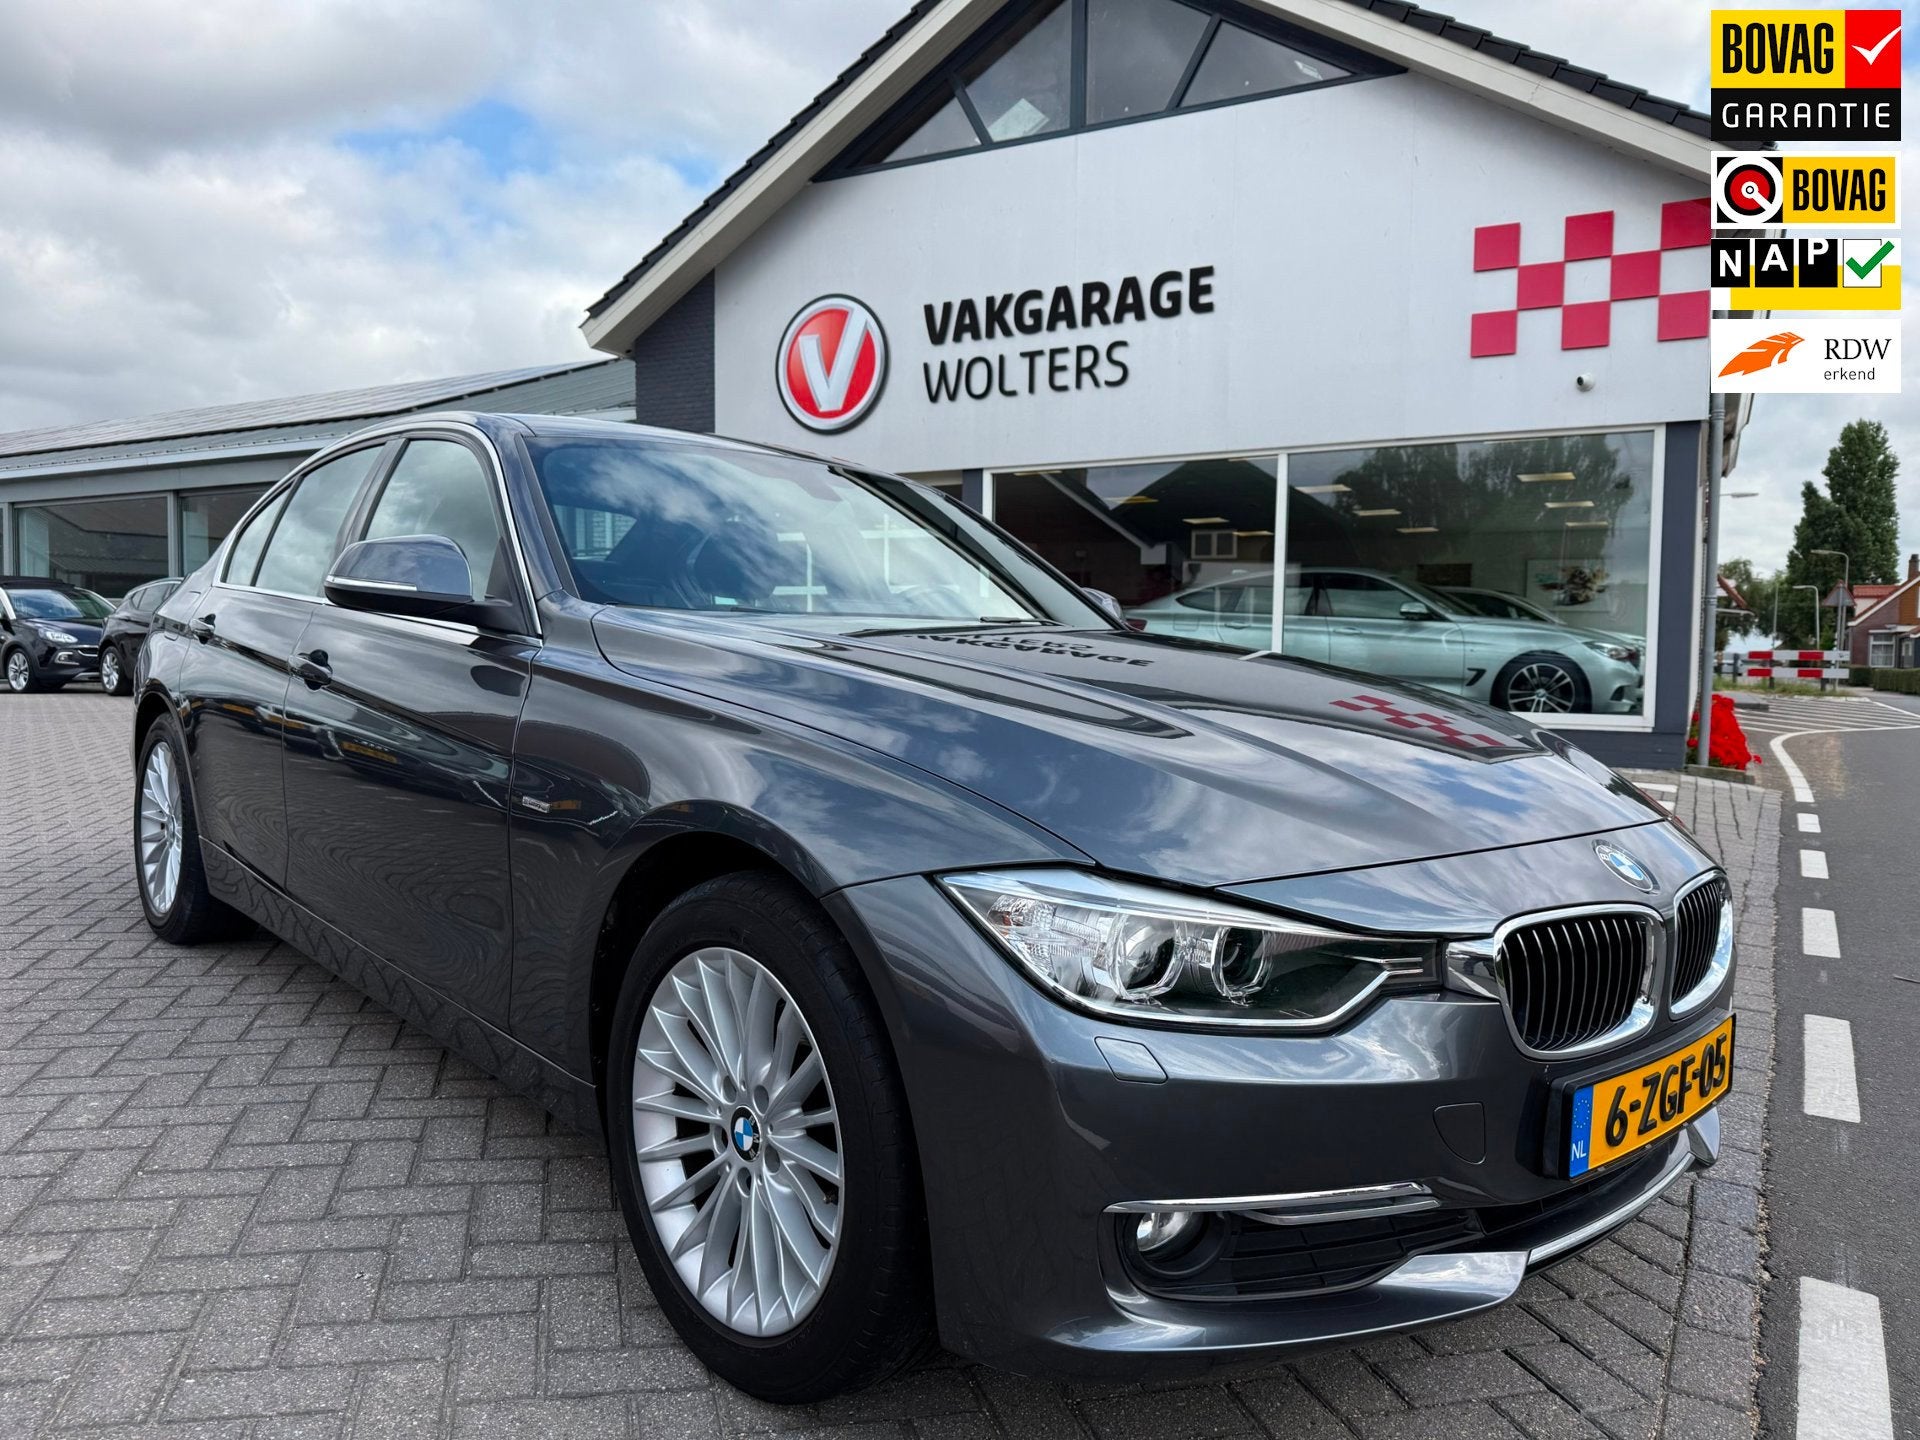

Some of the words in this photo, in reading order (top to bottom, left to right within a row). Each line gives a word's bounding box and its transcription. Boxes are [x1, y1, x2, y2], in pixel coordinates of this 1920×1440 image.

[923, 265, 1215, 346] VAKGARAGE
[923, 340, 1130, 403] WOLTERS
[1605, 1032, 1727, 1147] 6-ZGF-05
[1571, 1139, 1587, 1161] NL
